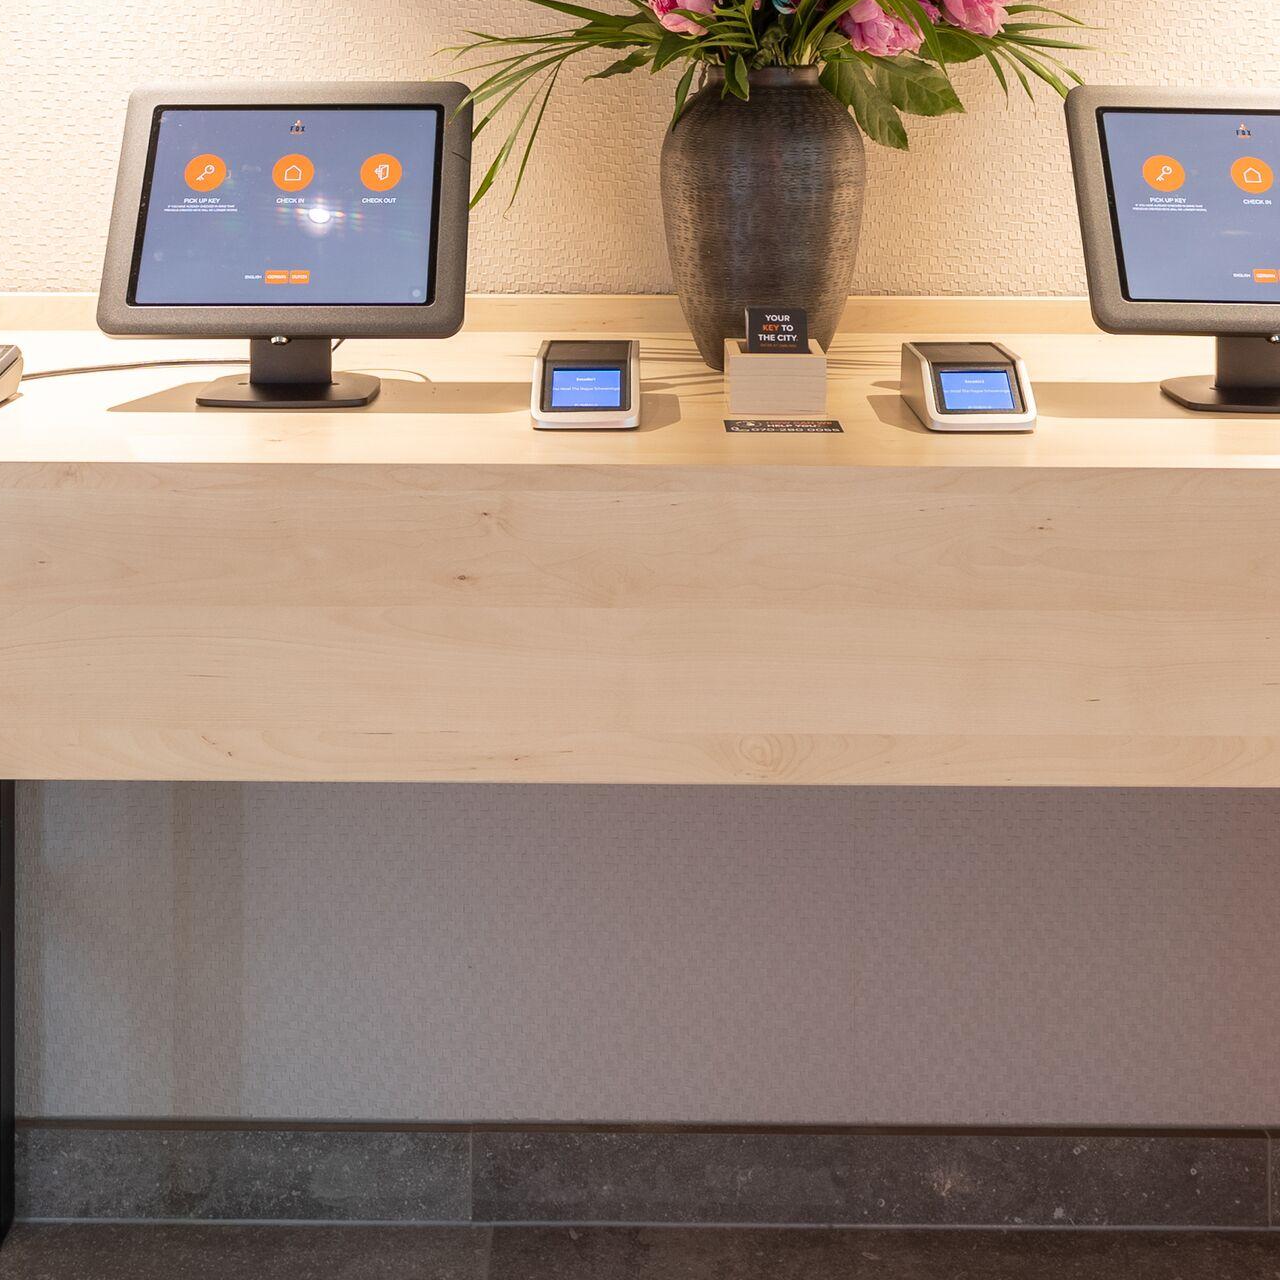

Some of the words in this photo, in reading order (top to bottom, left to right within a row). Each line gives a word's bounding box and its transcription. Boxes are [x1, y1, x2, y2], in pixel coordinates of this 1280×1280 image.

[765, 314, 791, 322] YOUR
[762, 324, 780, 332] KEY
[781, 324, 794, 332] TO
[758, 334, 776, 342] THE
